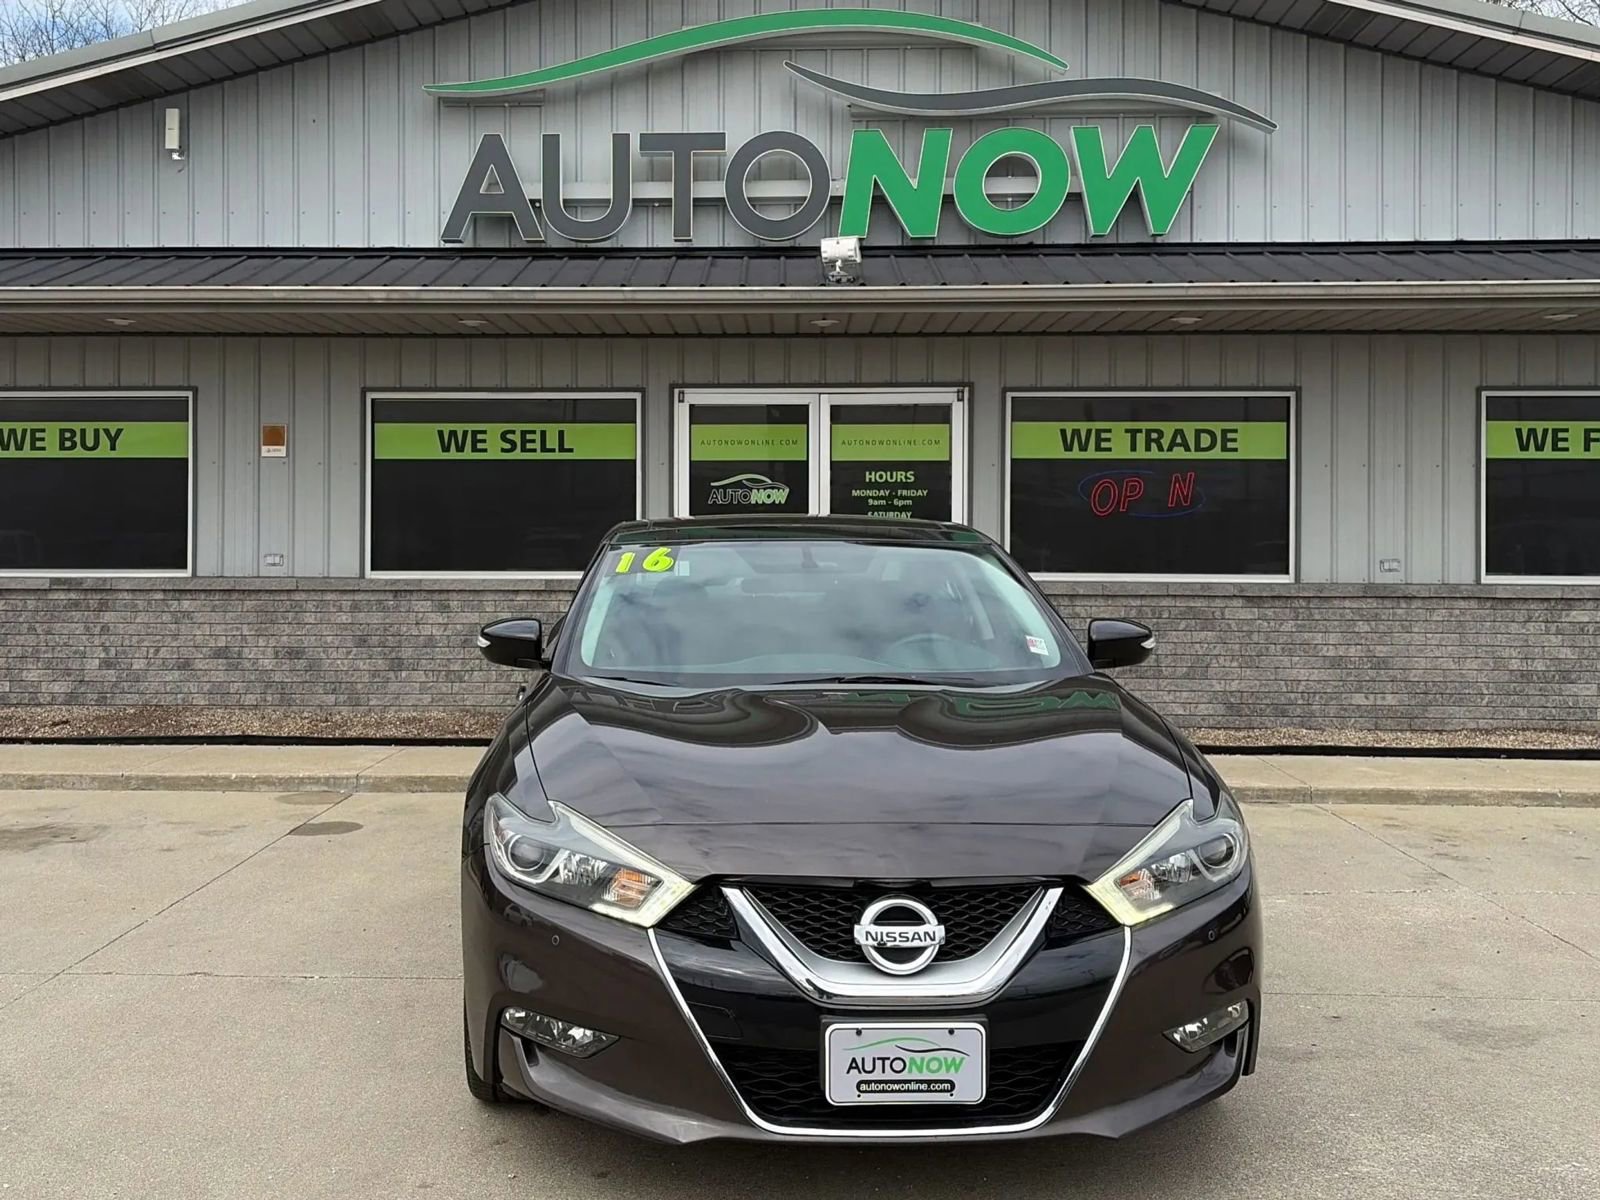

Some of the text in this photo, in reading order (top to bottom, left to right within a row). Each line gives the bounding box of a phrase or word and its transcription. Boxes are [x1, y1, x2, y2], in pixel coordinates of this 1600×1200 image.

[441, 123, 1219, 243] AUTONOW
[0, 428, 124, 452] WE BUY
[437, 429, 574, 453] WE SELL
[1059, 428, 1239, 452] WE TRADE
[1515, 428, 1570, 452] WE
[865, 471, 915, 482] HOURS
[708, 488, 789, 504] AUTONOW
[851, 489, 890, 497] MONDAY
[897, 489, 928, 497] FRIDAY
[893, 499, 912, 507] 6pm
[1091, 472, 1195, 517] OPN
[615, 547, 674, 573] 16
[865, 930, 936, 943] NISSAN
[846, 1056, 965, 1075] AUTONOW
[859, 1080, 951, 1092] autonowonline.com
